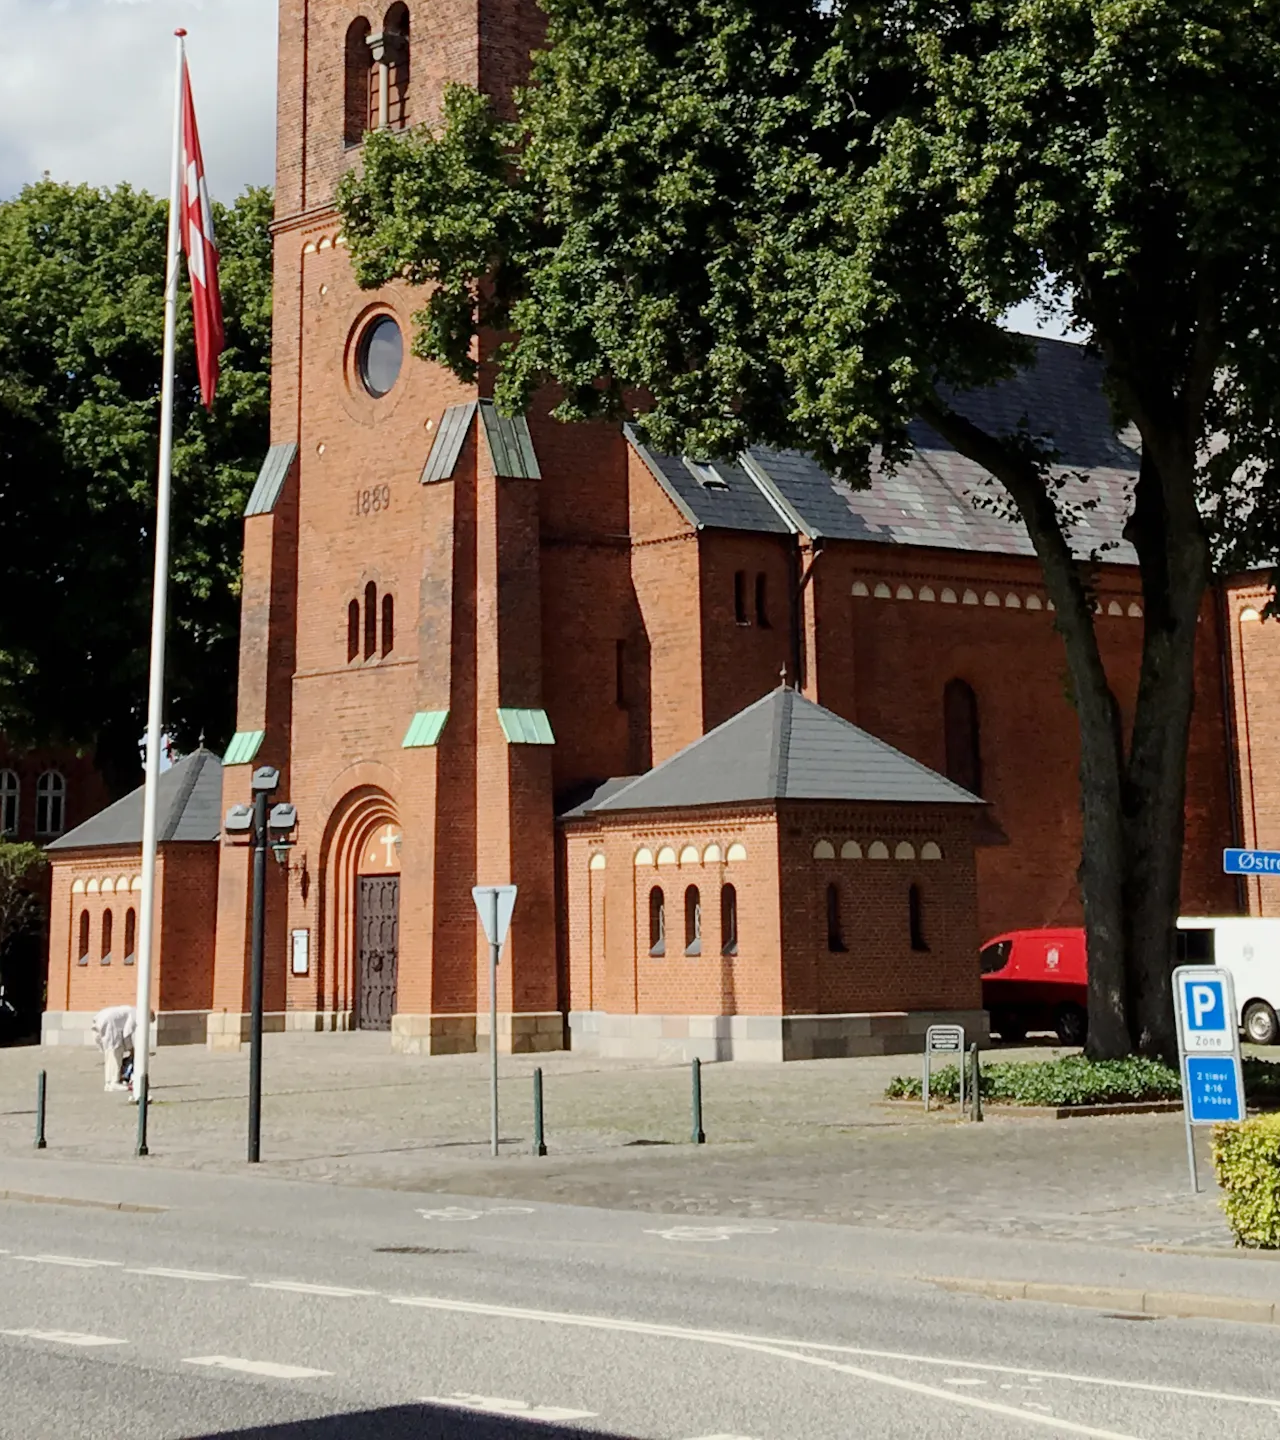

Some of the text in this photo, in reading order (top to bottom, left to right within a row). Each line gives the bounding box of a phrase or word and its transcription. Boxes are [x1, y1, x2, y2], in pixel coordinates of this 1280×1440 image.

[356, 484, 391, 516] 1889
[1192, 985, 1216, 1027] P
[1195, 1035, 1222, 1046] Zone
[1197, 1072, 1228, 1081] 2 timer
[1204, 1083, 1223, 1093] 8-16
